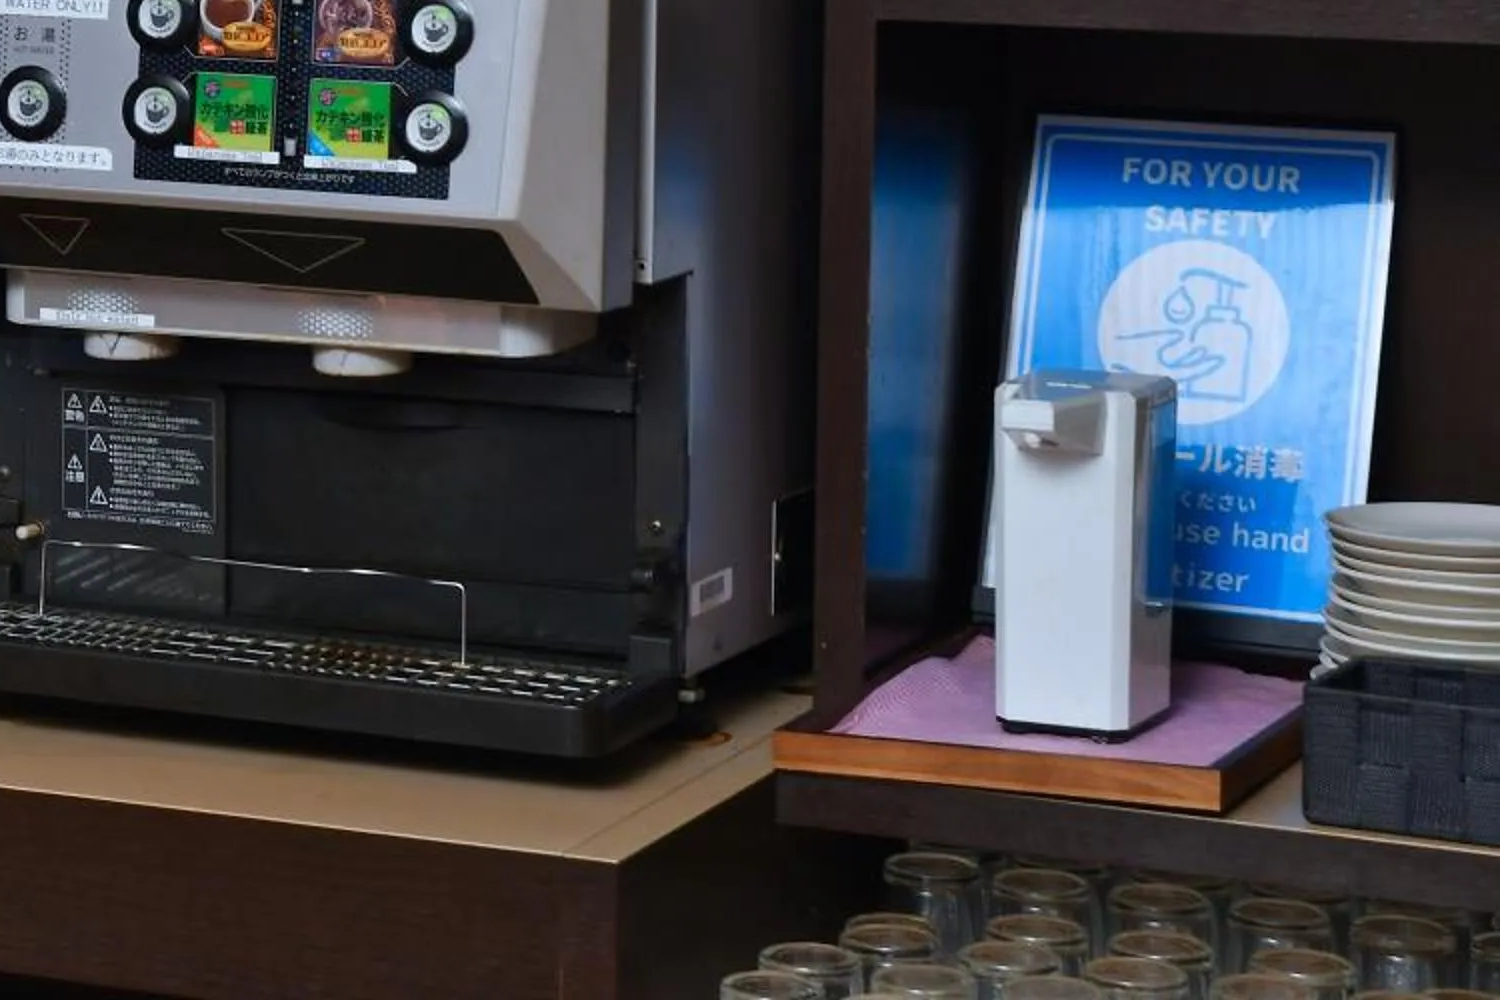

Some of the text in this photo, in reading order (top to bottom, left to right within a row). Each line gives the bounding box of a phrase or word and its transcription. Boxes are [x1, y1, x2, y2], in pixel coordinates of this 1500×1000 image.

[1123, 157, 1301, 193] FOR YOUR
[1144, 204, 1278, 239] SAFETY
[1231, 520, 1310, 554] hand
